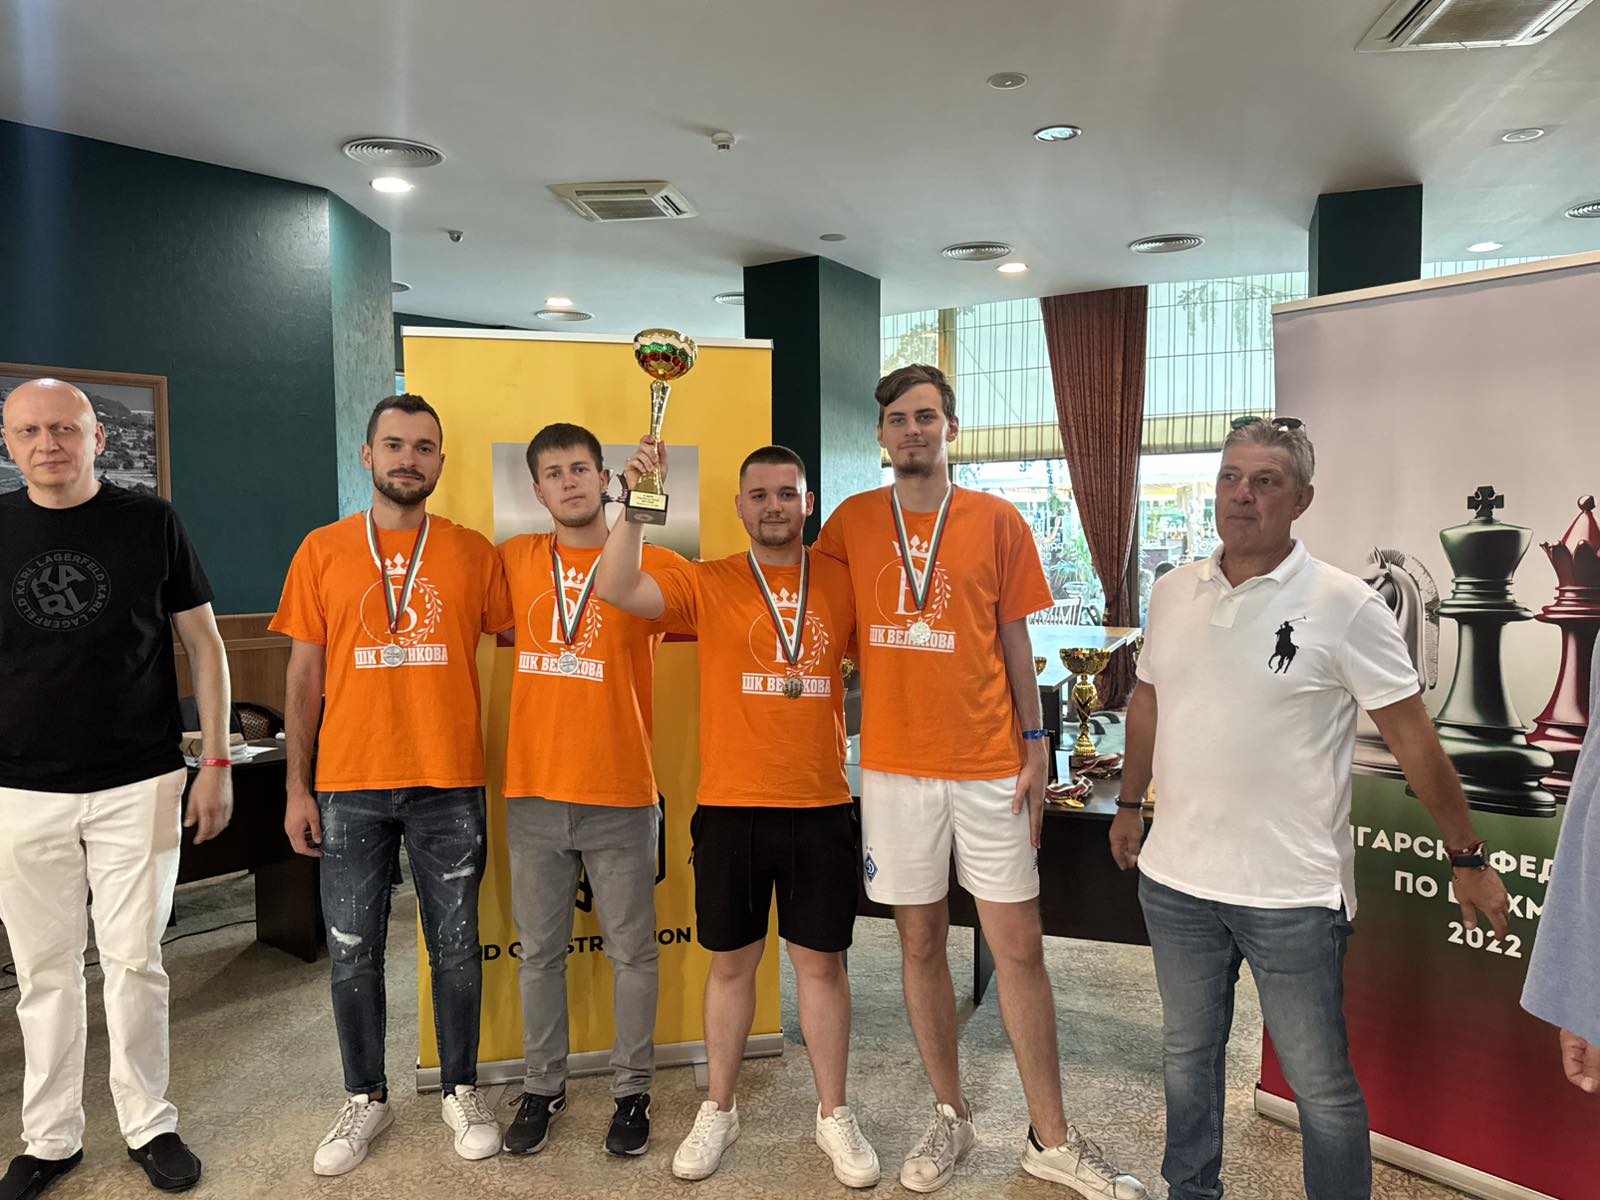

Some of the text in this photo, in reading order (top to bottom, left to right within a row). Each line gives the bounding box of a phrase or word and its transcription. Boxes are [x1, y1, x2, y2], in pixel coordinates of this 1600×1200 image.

[16, 553, 105, 595] KARL LAGERFELD
[869, 628, 885, 643] ШК
[355, 650, 377, 665] ШК
[518, 654, 538, 670] ШК
[742, 676, 831, 693] ШК ВЕКОВА
[1489, 850, 1554, 884] ФЕД
[1394, 870, 1438, 898] ПО
[1447, 921, 1522, 958] 2022
